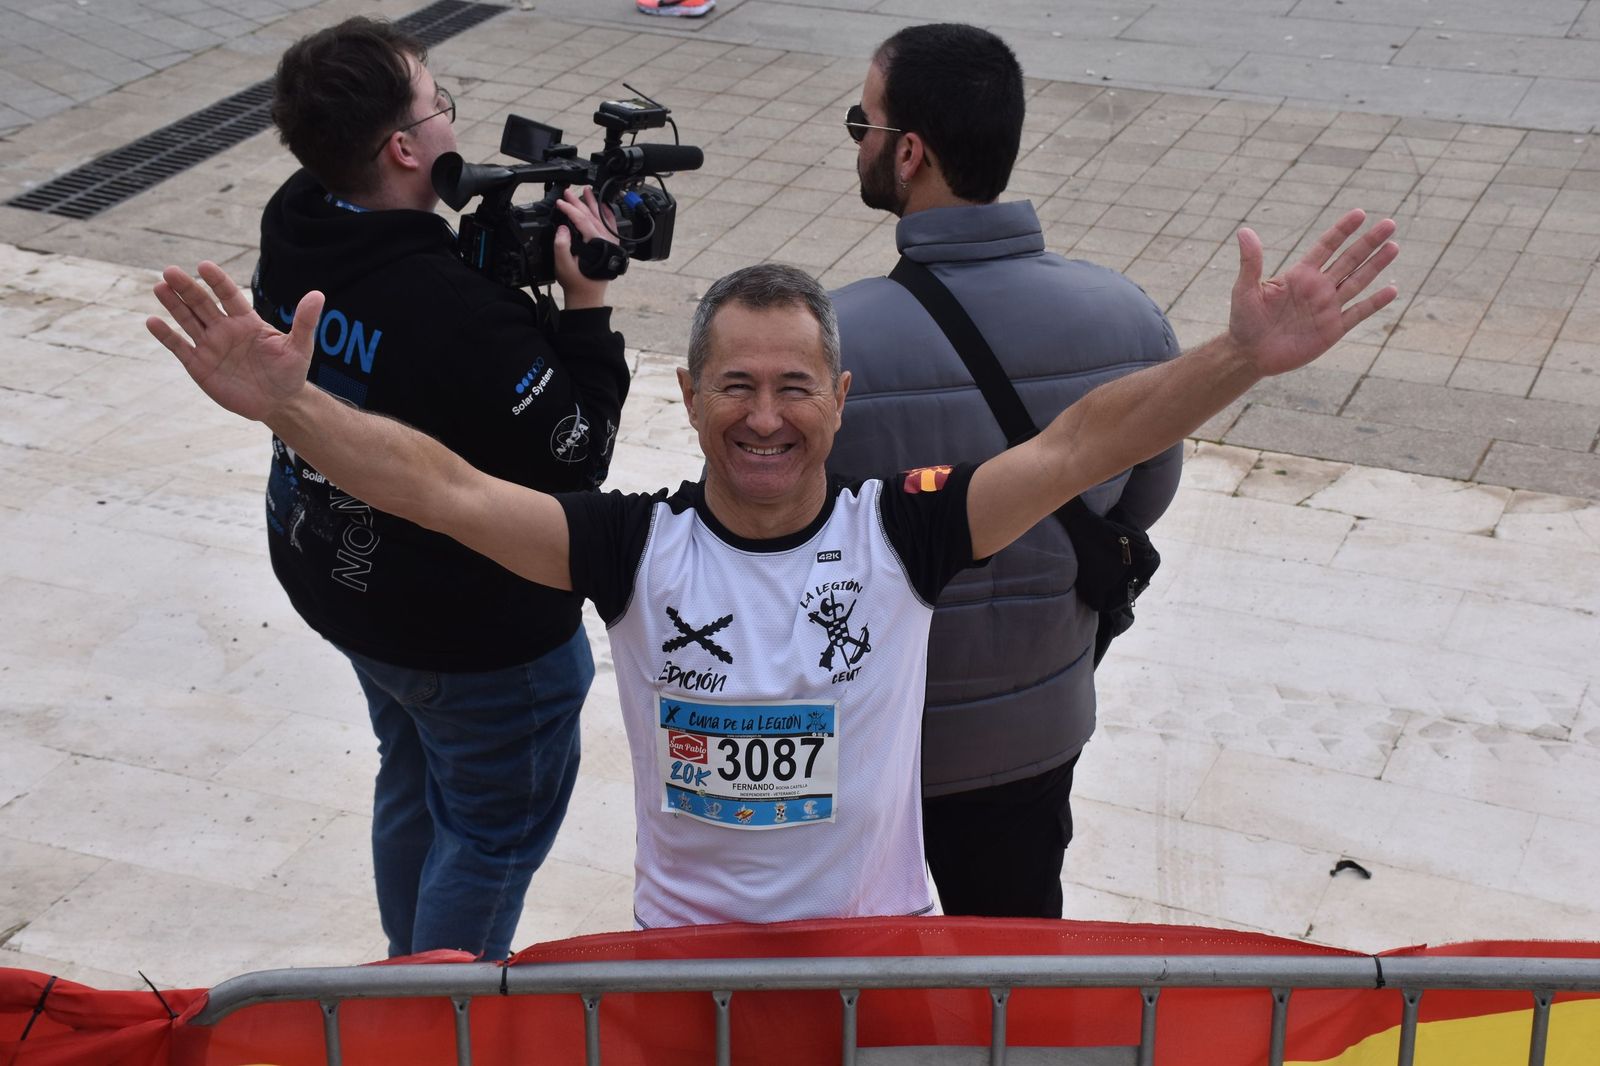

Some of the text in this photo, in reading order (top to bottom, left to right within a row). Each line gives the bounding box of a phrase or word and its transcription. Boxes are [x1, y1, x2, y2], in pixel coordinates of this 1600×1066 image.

[512, 367, 554, 416] Solar System
[556, 423, 589, 456] NASA
[302, 468, 326, 484] Solar
[818, 551, 840, 561] 42K
[800, 578, 863, 609] LA LEGIÓN
[658, 660, 727, 693] EDICIÓN
[665, 704, 681, 724] X
[669, 740, 707, 754] San Pablo
[717, 738, 825, 782] 3087
[670, 760, 712, 787] 20K
[732, 783, 775, 791] FERNANDO
